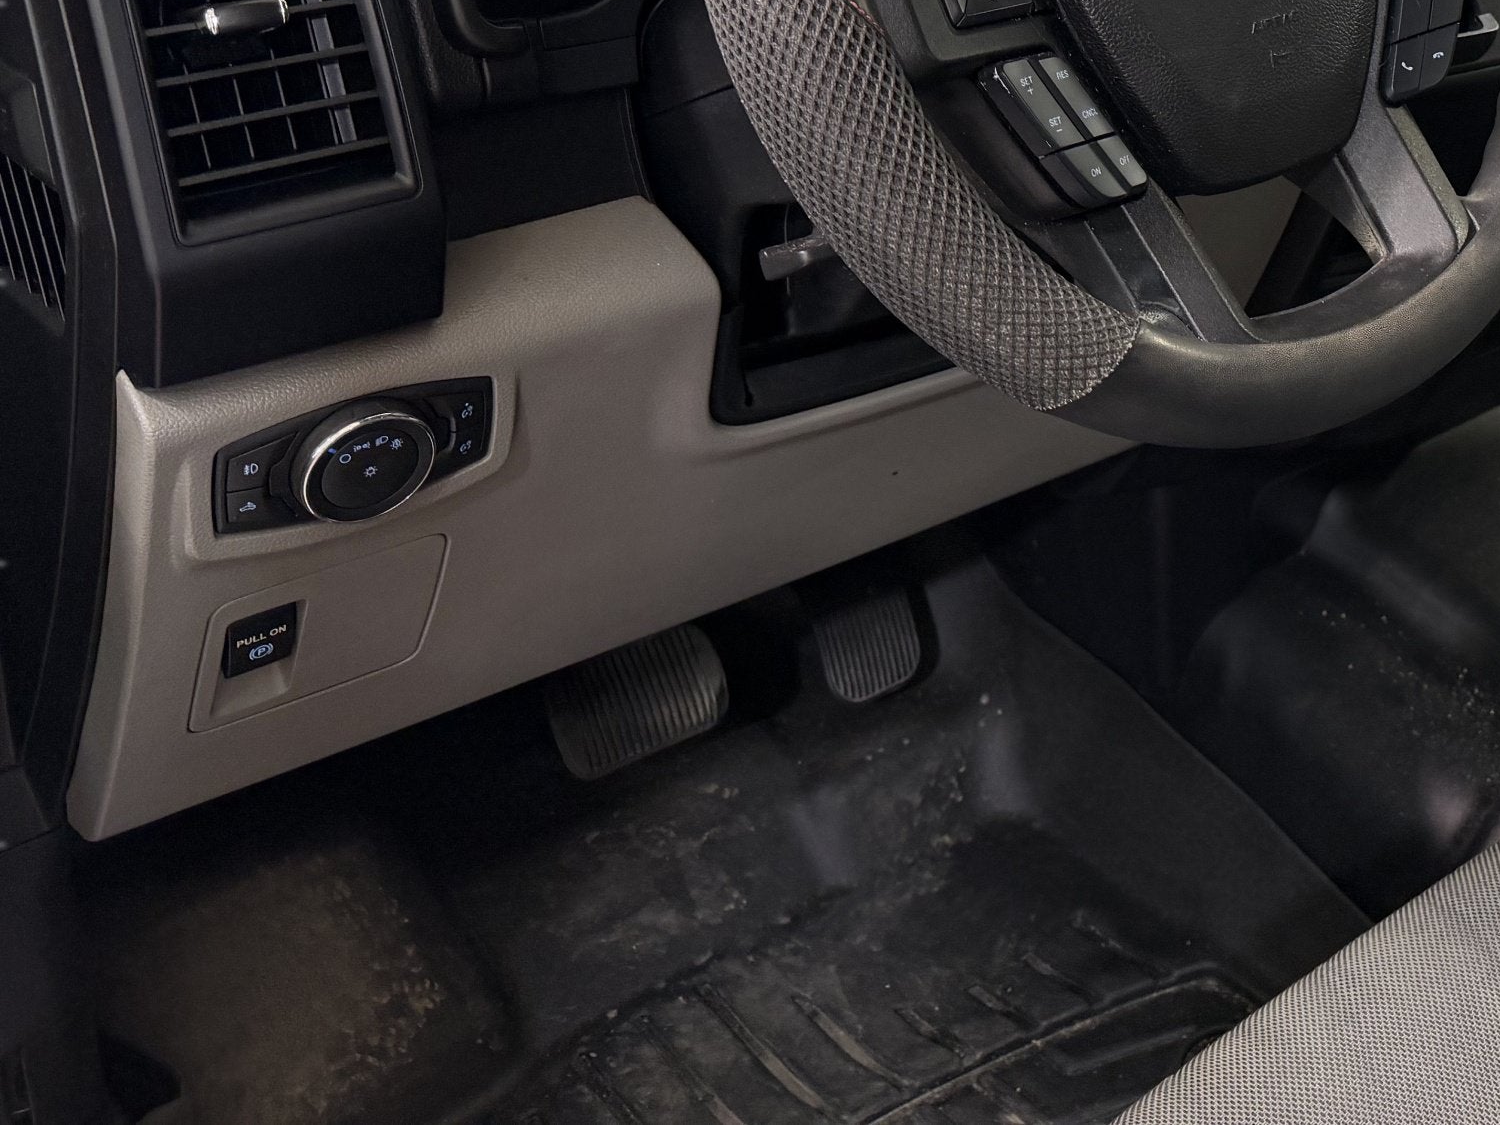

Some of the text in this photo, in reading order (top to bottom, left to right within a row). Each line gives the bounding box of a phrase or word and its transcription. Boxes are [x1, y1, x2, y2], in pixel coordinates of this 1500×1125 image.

[1056, 69, 1069, 81] RES
[1020, 75, 1033, 88] SET
[1048, 116, 1062, 128] SET
[1119, 155, 1130, 166] OFF
[1090, 168, 1102, 178] ON
[236, 624, 287, 649] PULL ON
